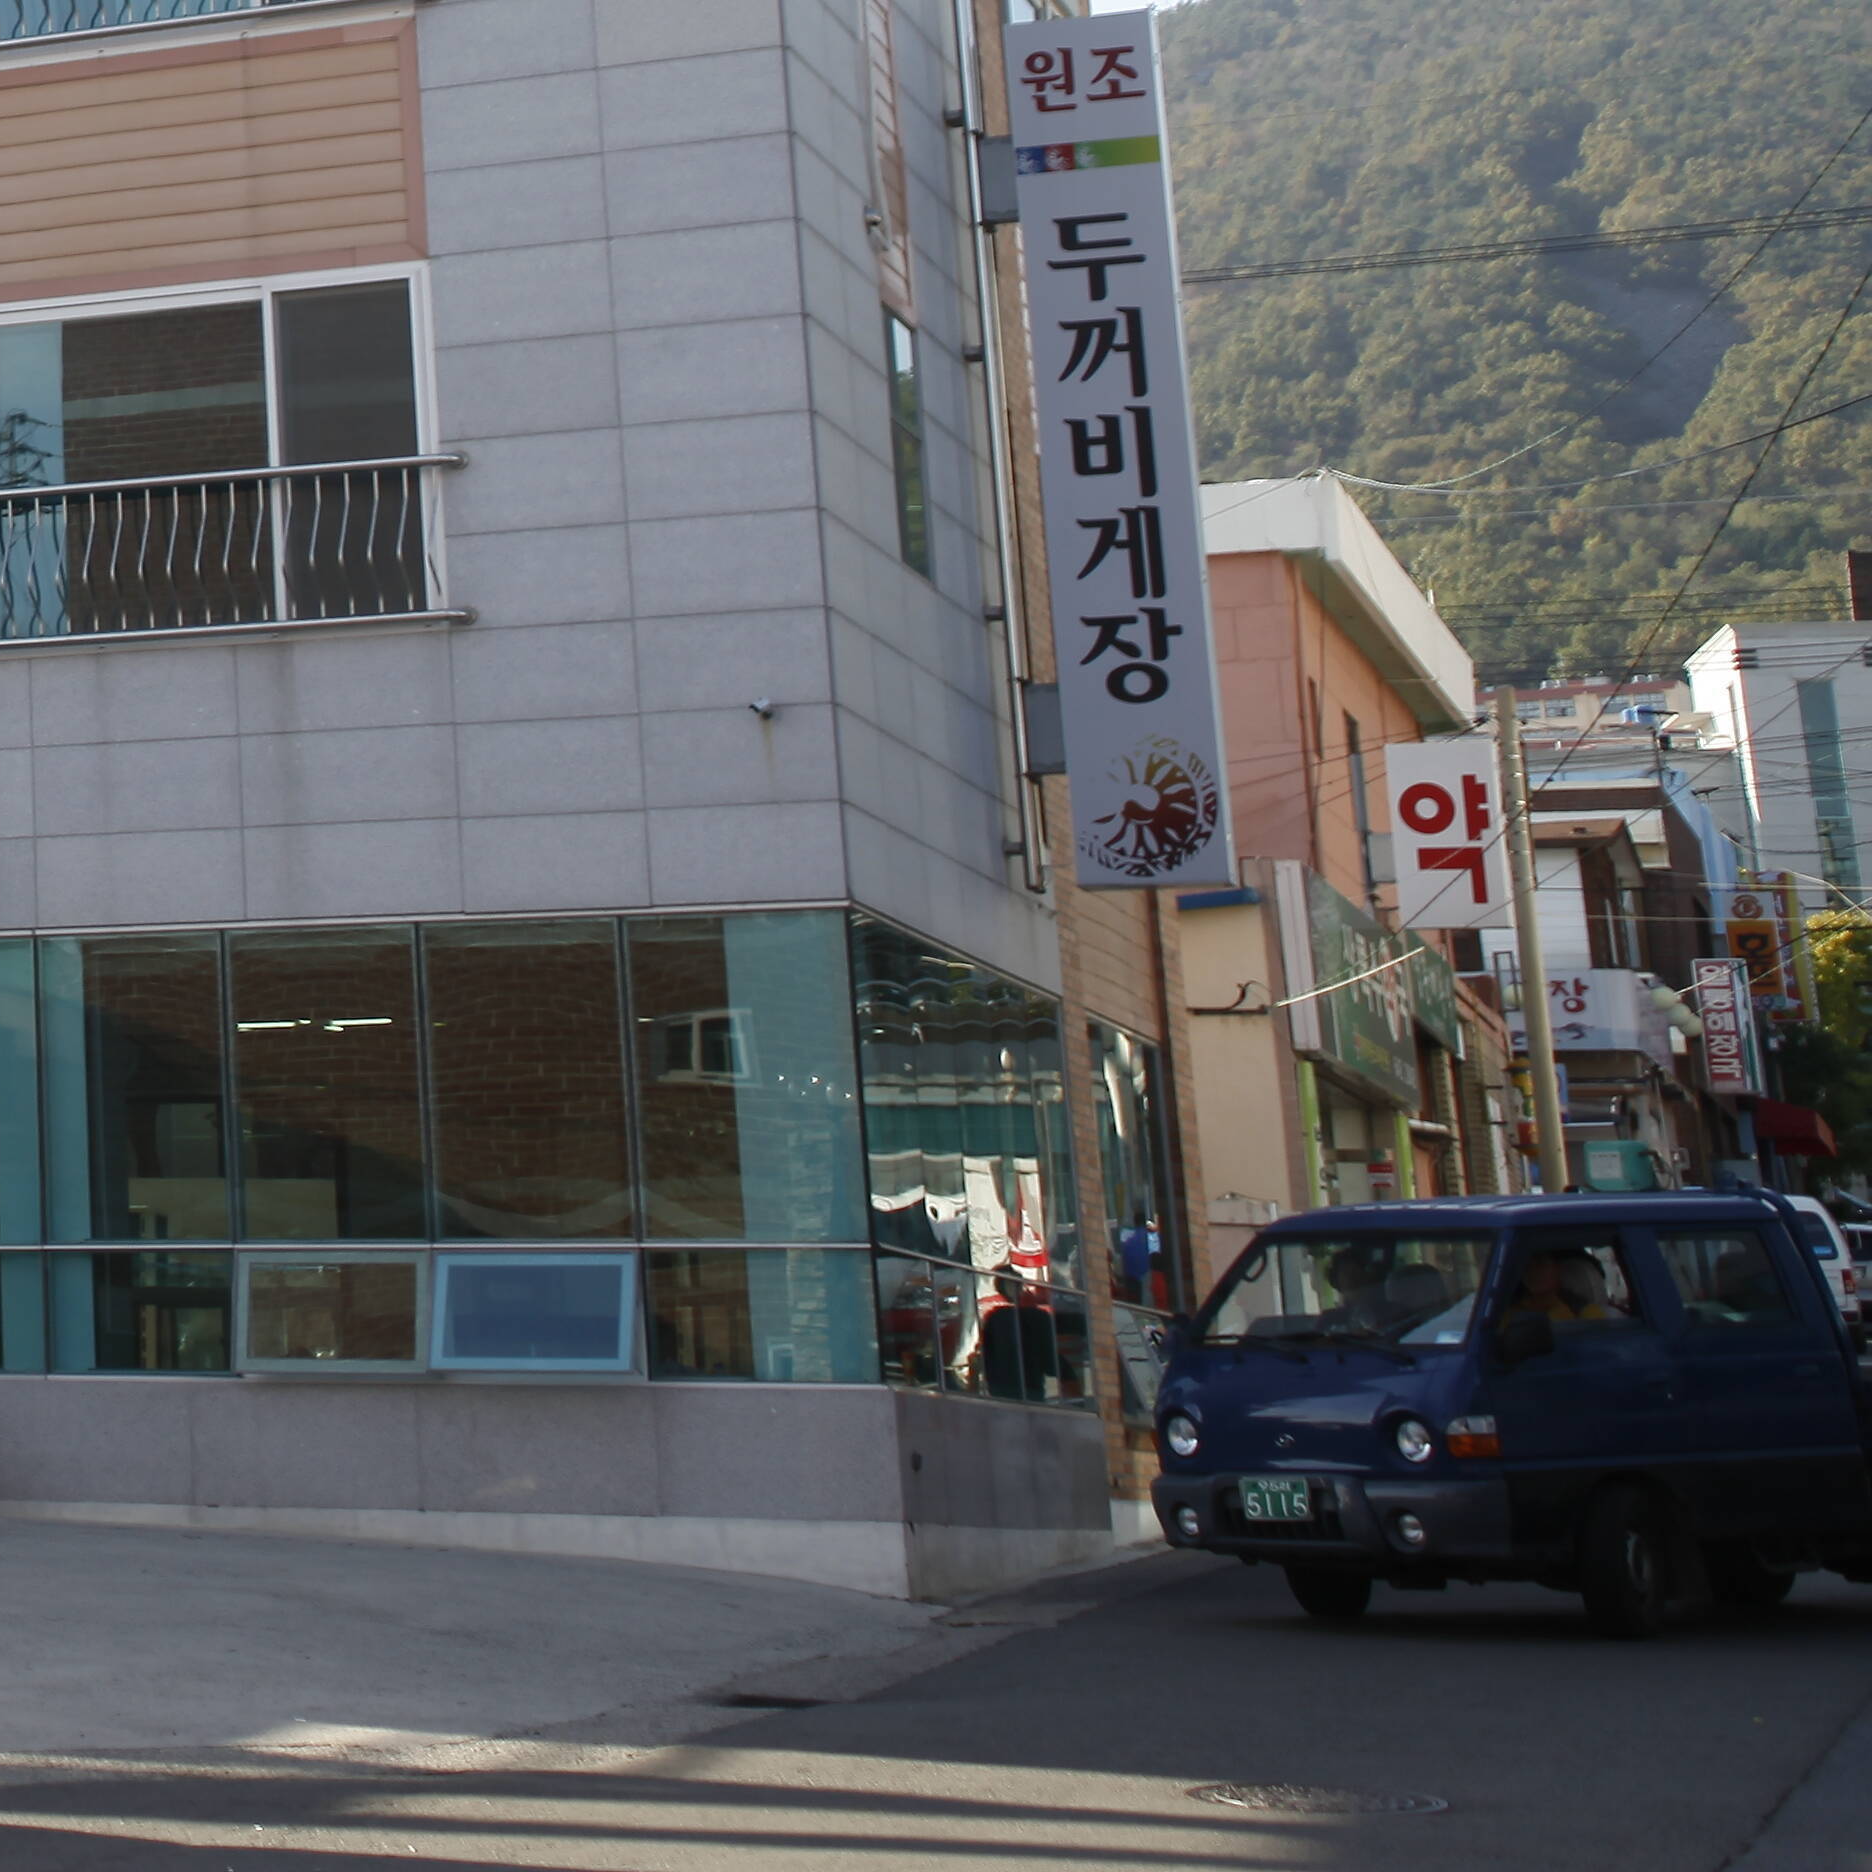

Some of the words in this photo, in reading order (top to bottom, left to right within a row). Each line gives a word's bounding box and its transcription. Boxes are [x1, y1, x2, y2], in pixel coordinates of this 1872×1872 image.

[1020, 45, 1147, 113] 원조
[1048, 212, 1183, 704] 두꺼비게장
[1398, 774, 1490, 904] 약
[1247, 1491, 1308, 1517] 5115
